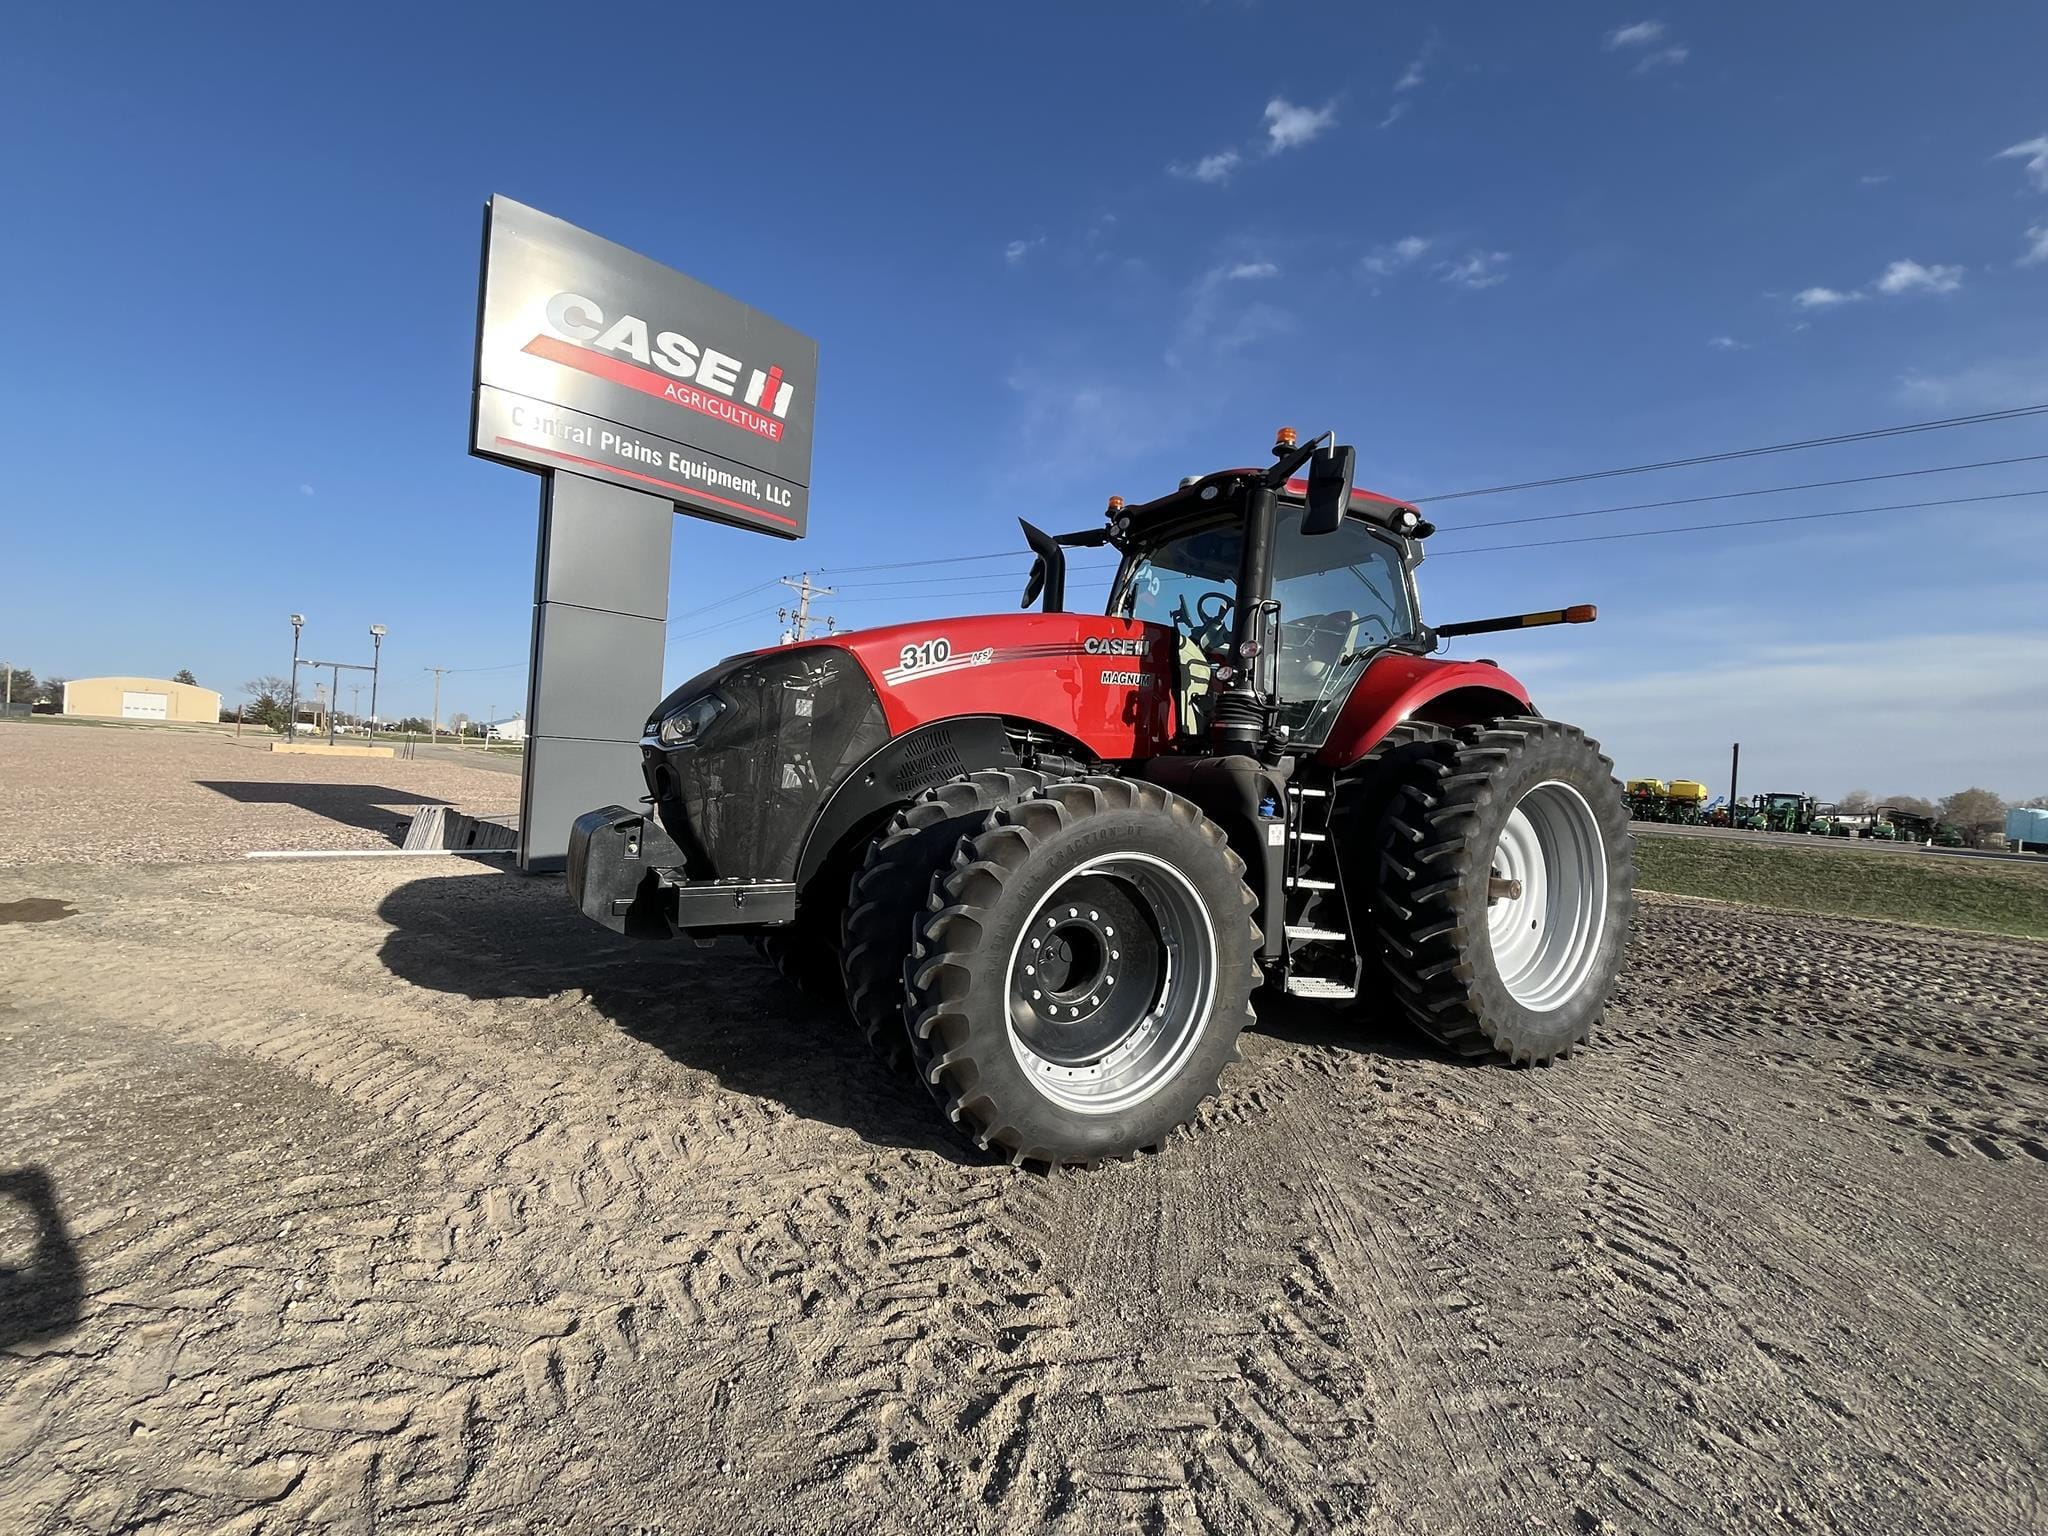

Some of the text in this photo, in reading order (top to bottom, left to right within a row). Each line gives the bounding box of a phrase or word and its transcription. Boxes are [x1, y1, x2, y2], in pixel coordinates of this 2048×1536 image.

[546, 292, 743, 396] CASE
[664, 383, 778, 439] AGRICULTURE
[600, 431, 663, 467] Plains
[668, 451, 761, 500] Equipment,
[765, 483, 792, 507] LLC
[902, 639, 950, 670] 310
[1084, 637, 1134, 655] CASE
[1101, 671, 1151, 687] MAGNUM
